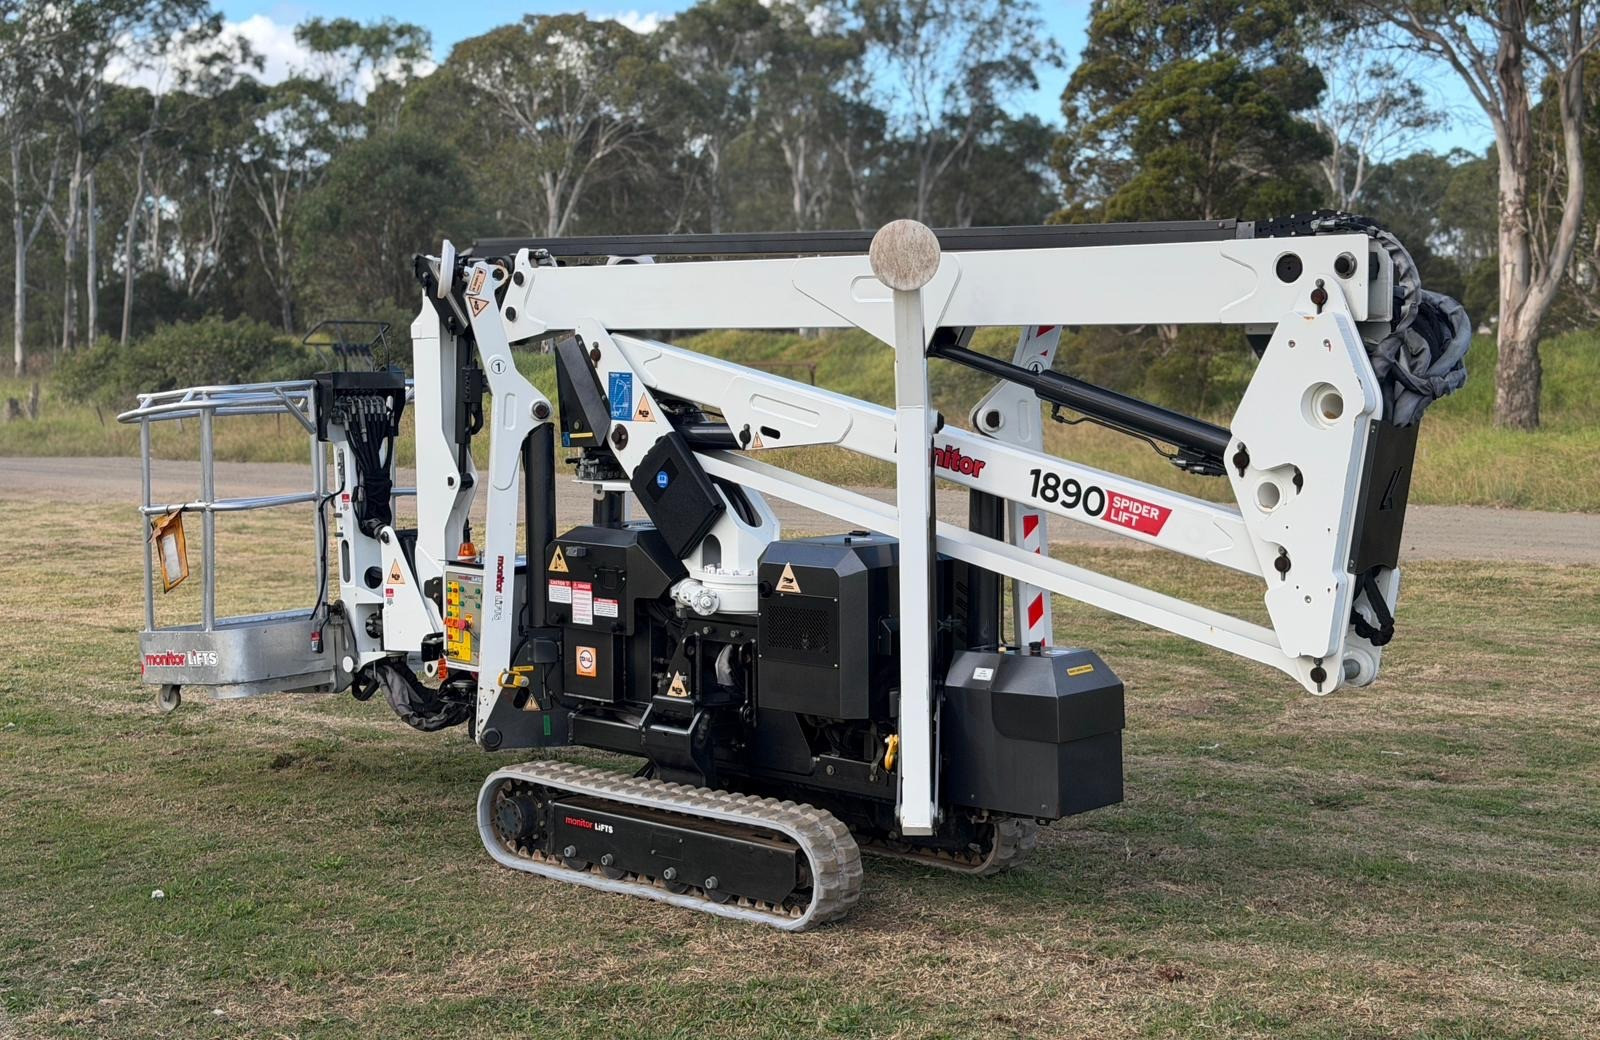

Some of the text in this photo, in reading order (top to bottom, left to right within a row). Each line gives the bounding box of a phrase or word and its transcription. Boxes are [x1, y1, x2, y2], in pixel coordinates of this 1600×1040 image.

[934, 446, 986, 478] nitor
[1030, 469, 1105, 517] 1890
[1110, 508, 1139, 527] LIFT
[1112, 496, 1159, 520] SPIDER
[496, 555, 505, 594] monitor
[145, 650, 186, 666] monitor
[565, 816, 593, 829] monitor
